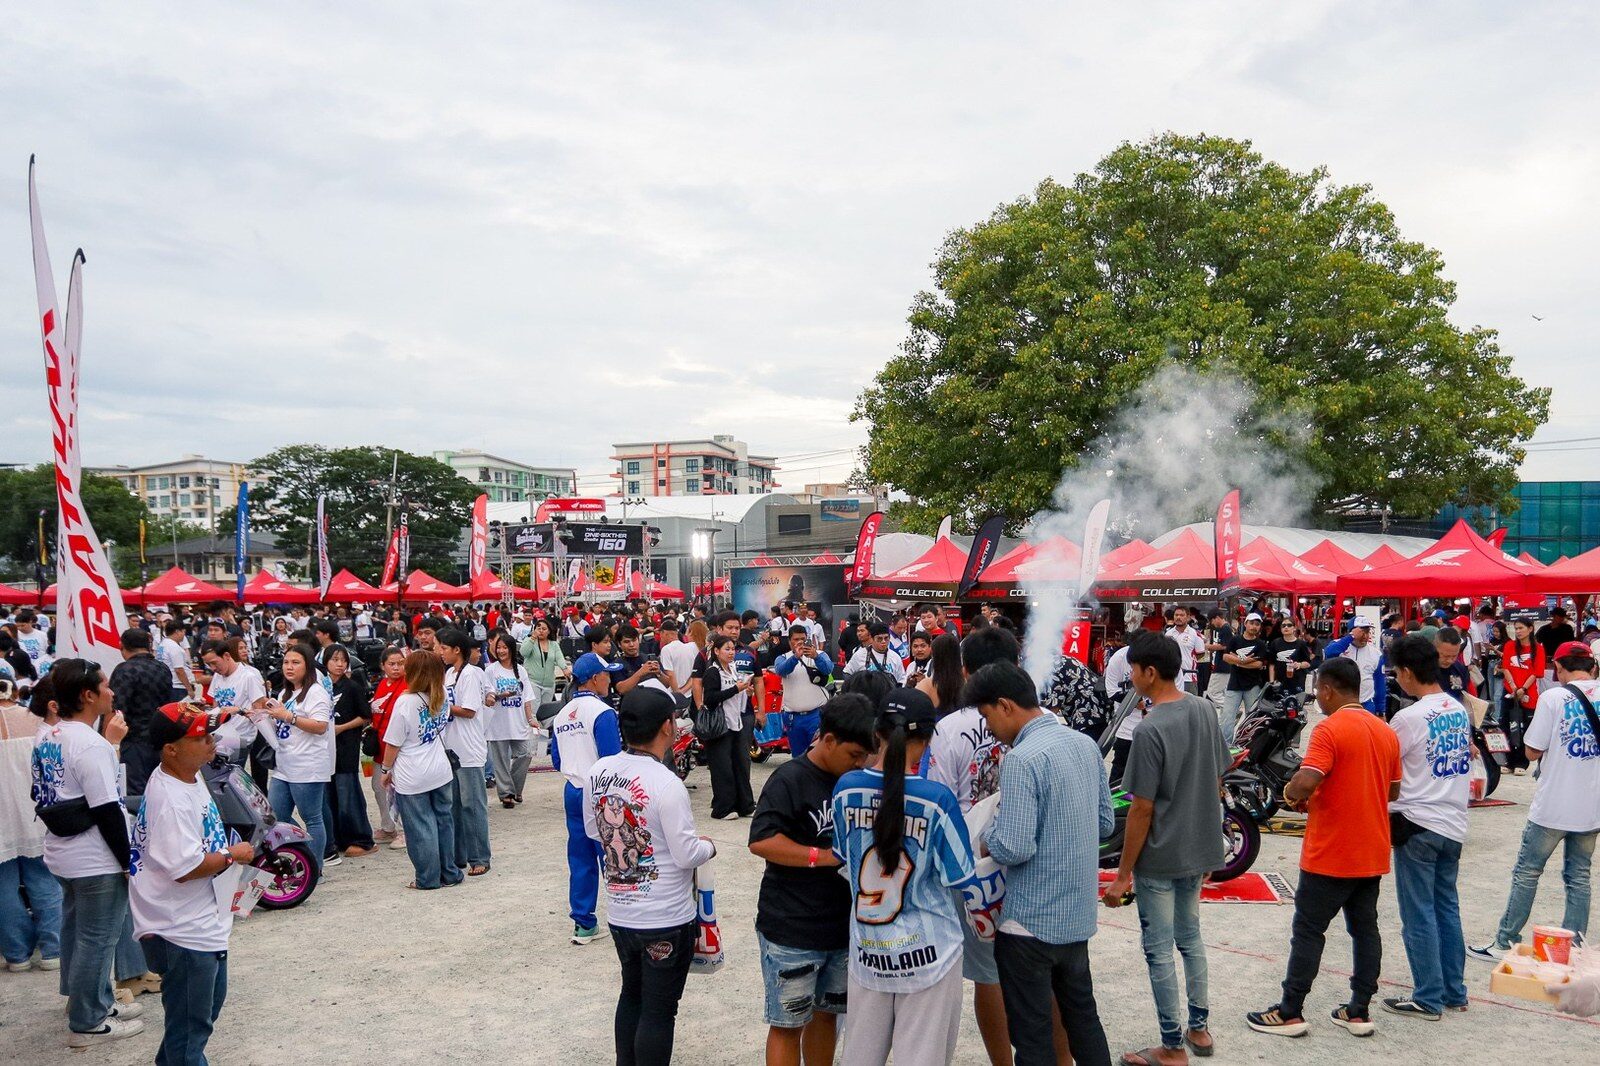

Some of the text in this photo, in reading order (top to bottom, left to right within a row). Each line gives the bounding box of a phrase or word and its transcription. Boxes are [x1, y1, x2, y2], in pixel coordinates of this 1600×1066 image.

[598, 538, 627, 551] 160
[856, 520, 875, 578] SALE
[1222, 502, 1233, 575] SALE
[896, 588, 953, 598] COLLECTION
[1142, 587, 1218, 597] COLLECTION
[1427, 710, 1469, 740] HONDA
[1434, 733, 1468, 755] ASIA
[1432, 751, 1471, 778] CLUB
[855, 845, 915, 926] 9
[857, 945, 938, 972] THAILAND
